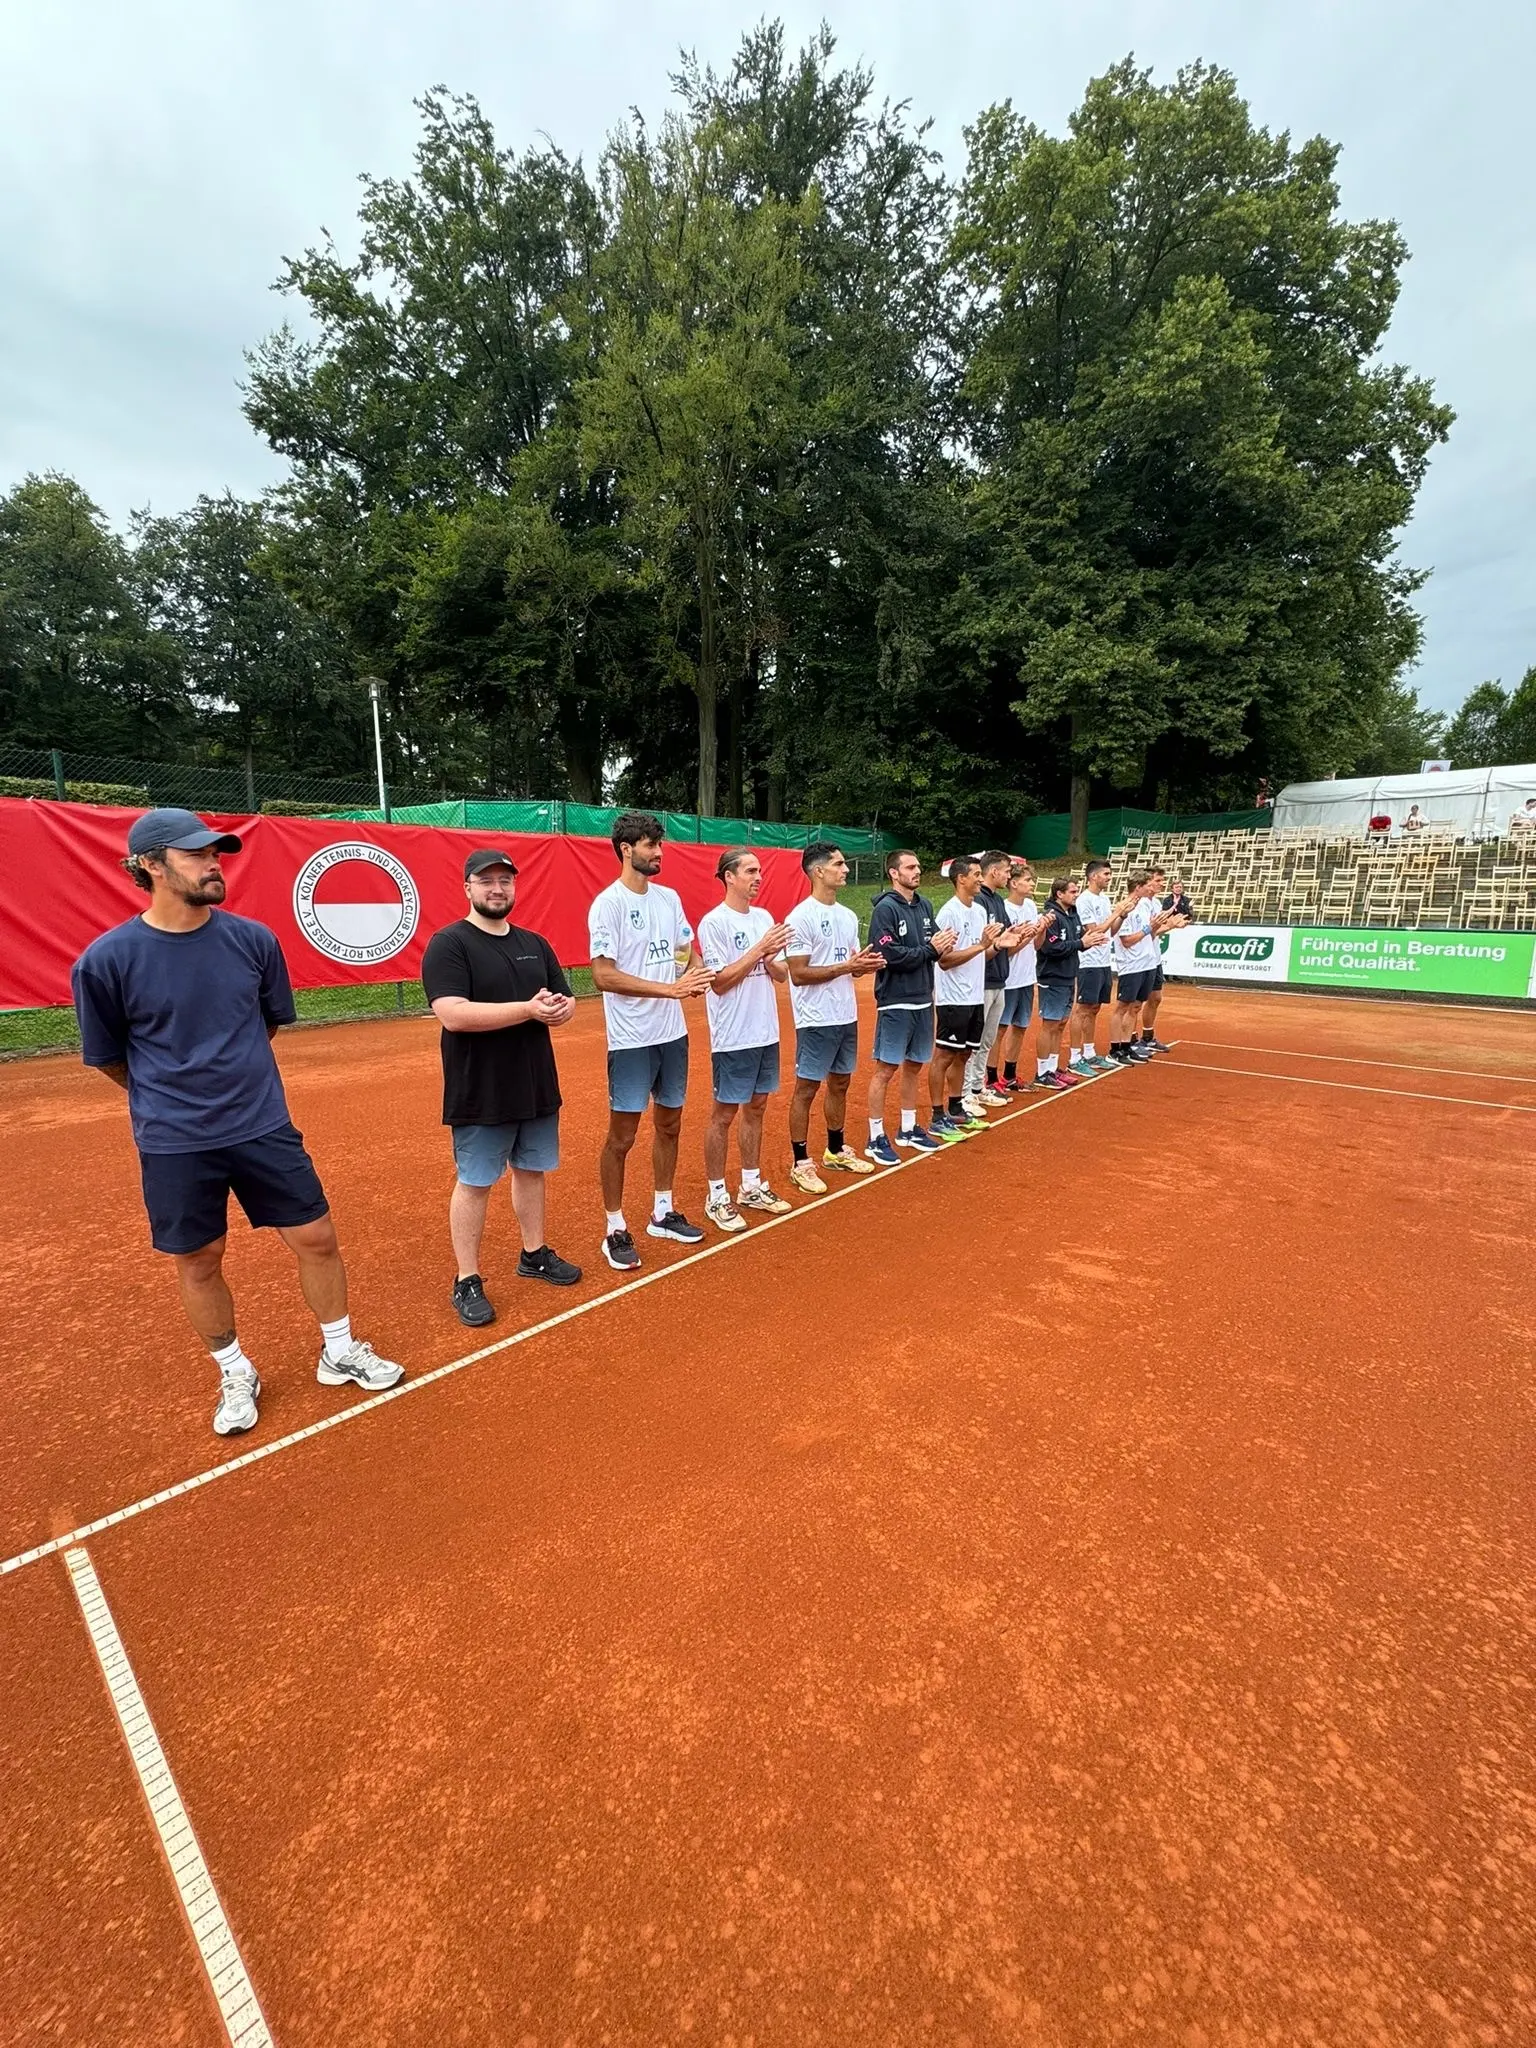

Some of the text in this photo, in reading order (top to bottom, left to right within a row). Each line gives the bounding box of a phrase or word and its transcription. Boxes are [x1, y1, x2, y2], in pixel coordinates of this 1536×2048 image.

[368, 851, 390, 868] UND
[312, 928, 363, 959] ROT-WEISS
[366, 930, 405, 958] STADION
[1201, 938, 1267, 960] taxofit
[1302, 937, 1506, 962] Führend in Beratung
[1193, 961, 1222, 970] SPÜRBAR
[1238, 964, 1272, 972] VERSORGT
[1300, 954, 1420, 971] und Qualität.
